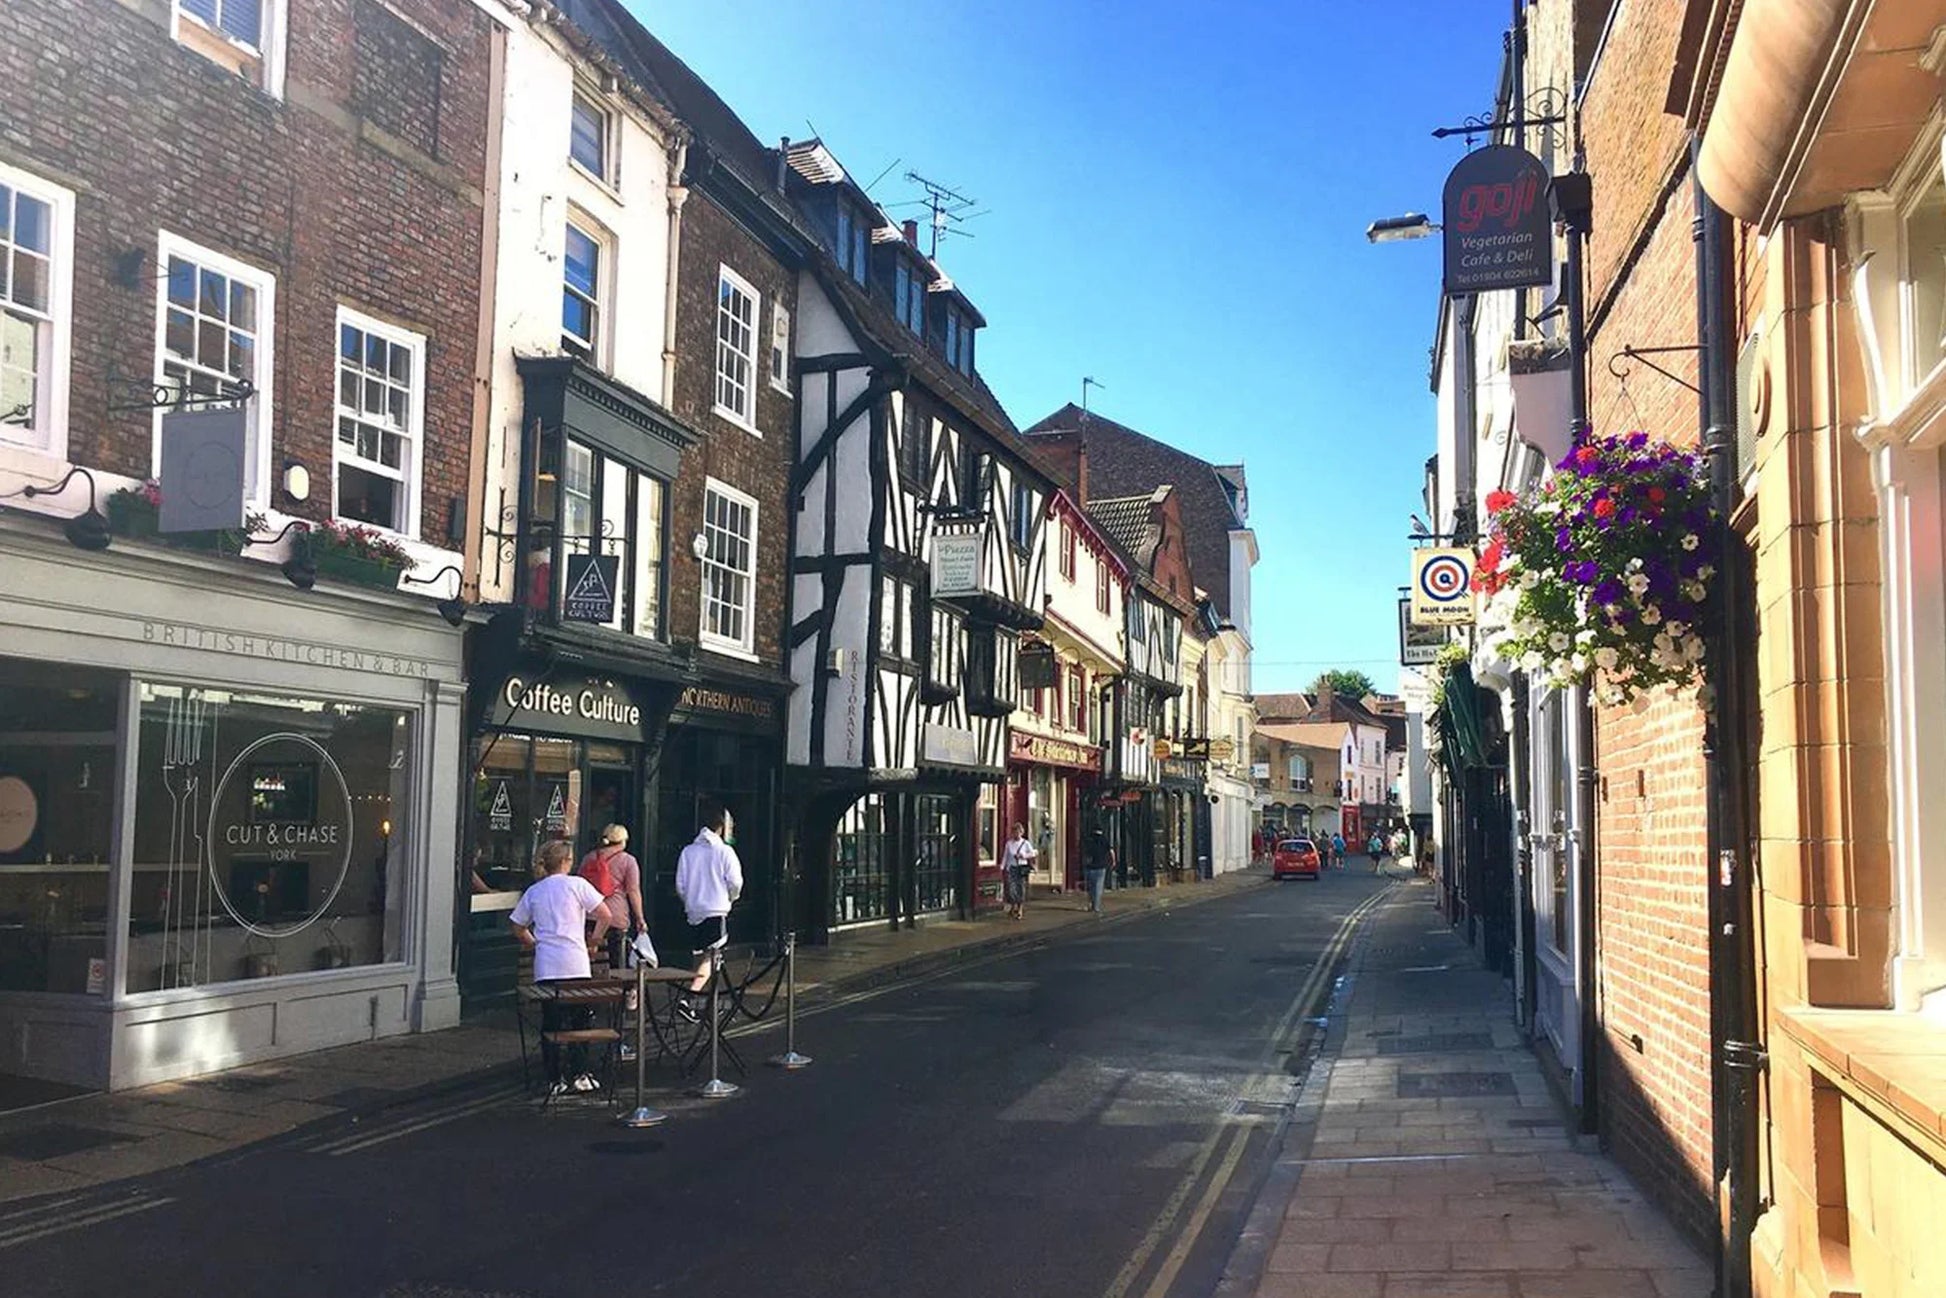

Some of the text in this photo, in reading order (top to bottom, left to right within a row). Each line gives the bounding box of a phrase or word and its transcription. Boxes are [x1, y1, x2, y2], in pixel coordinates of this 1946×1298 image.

[1457, 169, 1537, 232] goji
[1462, 231, 1533, 250] Vegetarian
[1461, 248, 1534, 268] Cafe & Deli
[143, 620, 429, 677] BRITISH KITCHEN & BAR
[505, 677, 641, 726] Coffee Culture
[226, 822, 339, 845] CUT & CHASE
[269, 848, 297, 861] YORK
